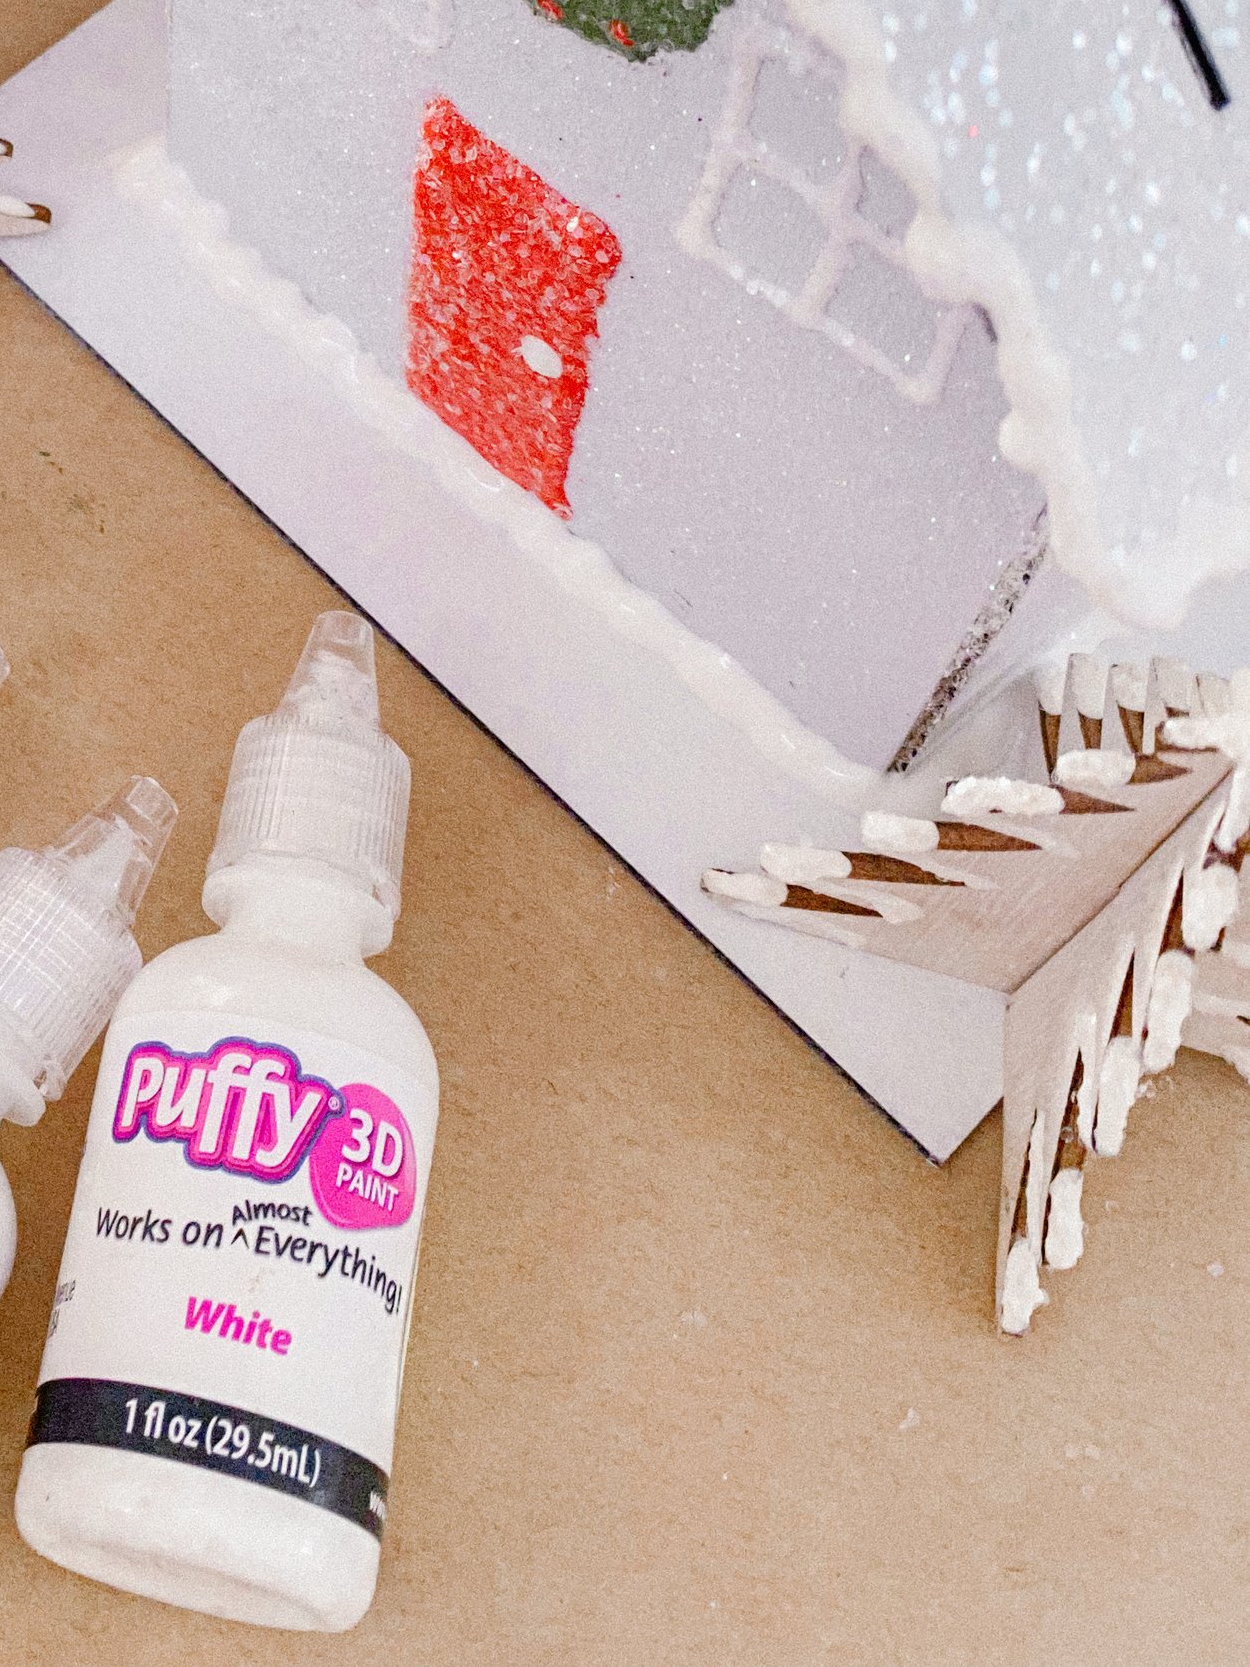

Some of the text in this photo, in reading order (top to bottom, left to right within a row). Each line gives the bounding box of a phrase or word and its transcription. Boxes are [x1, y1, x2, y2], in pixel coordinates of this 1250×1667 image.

[340, 1109, 405, 1179] 3D
[231, 1199, 313, 1227] Almost
[335, 1168, 400, 1212] PAINT
[95, 1206, 403, 1314] Works on Everything!
[183, 1296, 293, 1356] White
[124, 1399, 322, 1488] 1 fl oz (29.5mL)
